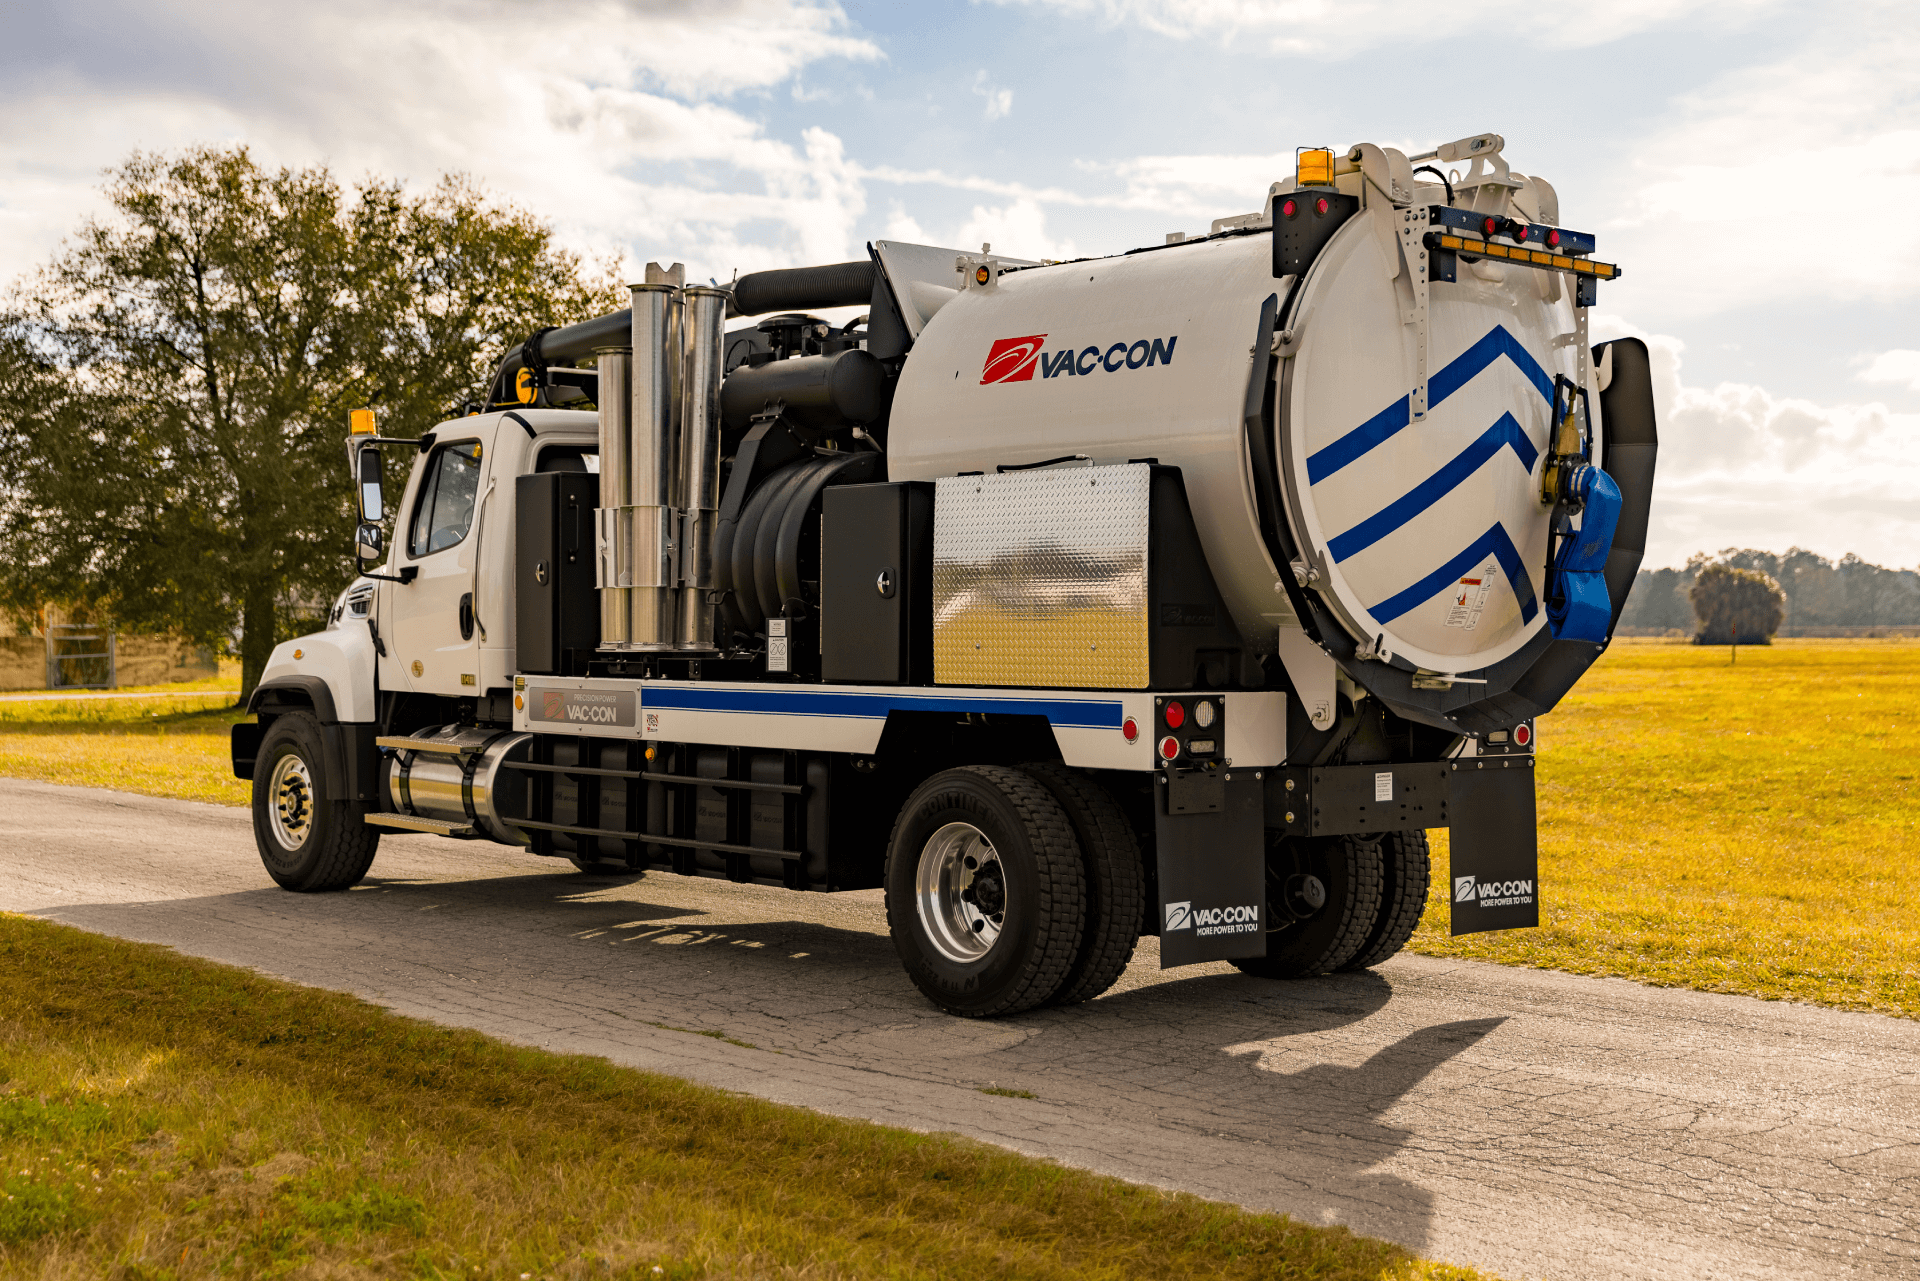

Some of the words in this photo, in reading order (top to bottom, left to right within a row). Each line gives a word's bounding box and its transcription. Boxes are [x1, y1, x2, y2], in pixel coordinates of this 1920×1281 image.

[573, 693, 599, 702] PRECISION
[599, 694, 617, 703] POWER
[1480, 899, 1494, 907] MORE
[1494, 897, 1513, 907] POWER
[1513, 896, 1520, 904] TO
[1520, 895, 1532, 904] YOU
[1196, 926, 1213, 937] MORE
[1213, 925, 1235, 935] POWER
[1235, 924, 1244, 933] TO
[1244, 923, 1258, 932] YOU
